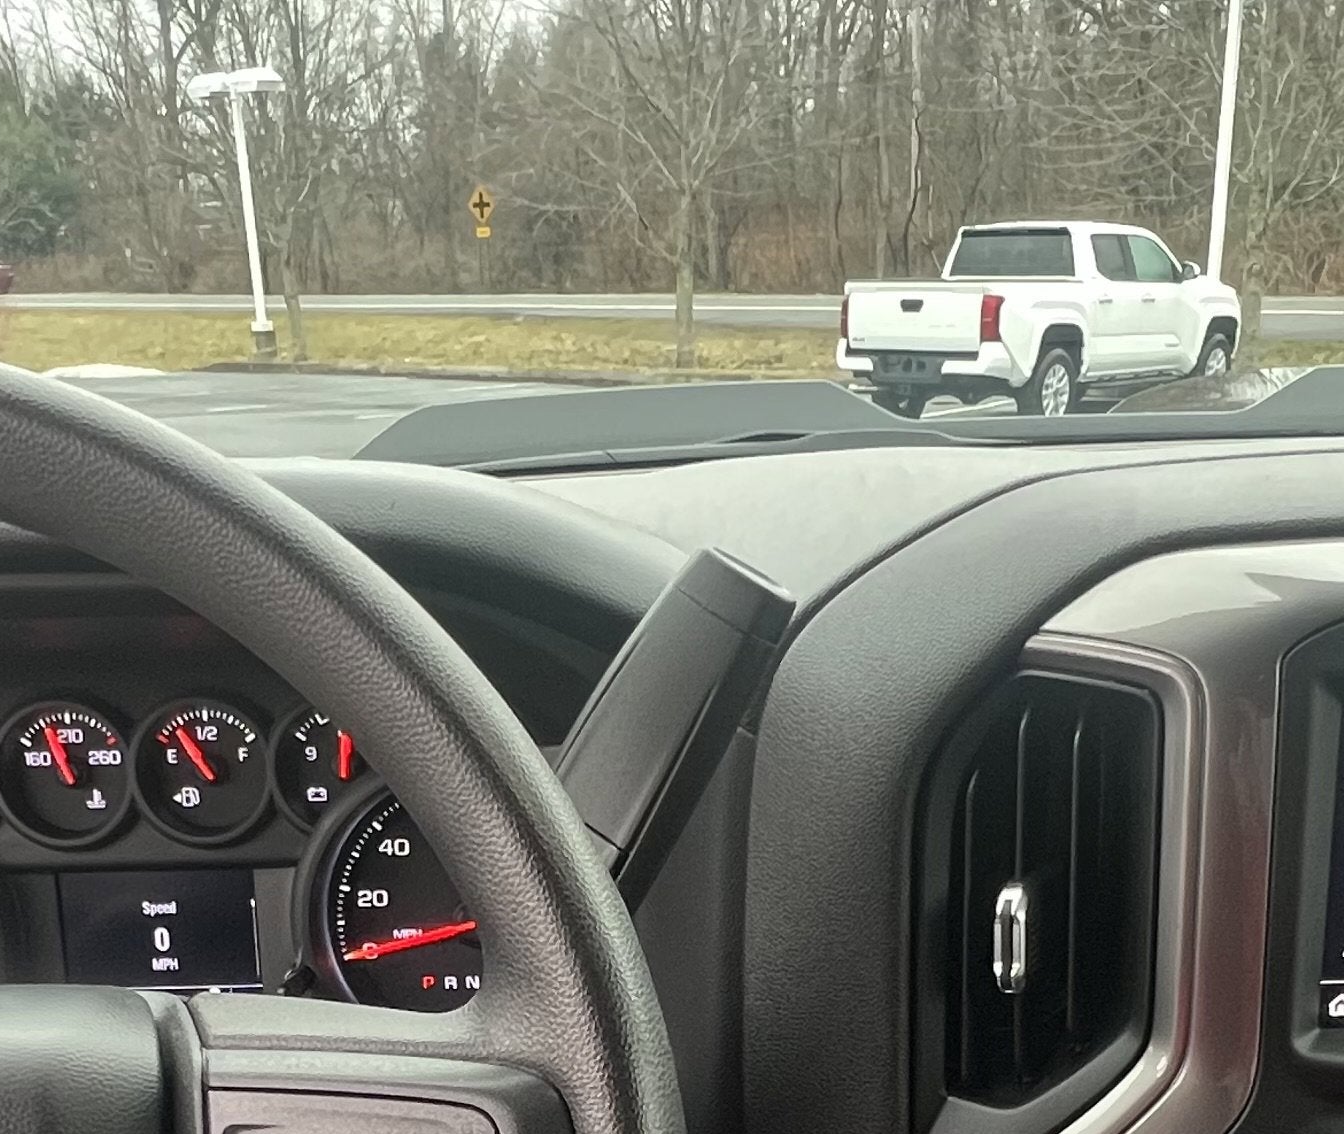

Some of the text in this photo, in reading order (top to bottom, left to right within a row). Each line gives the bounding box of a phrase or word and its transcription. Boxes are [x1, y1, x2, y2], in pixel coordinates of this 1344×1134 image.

[56, 729, 84, 744] 210
[195, 726, 218, 741] 1/2
[24, 751, 51, 767] 160
[88, 750, 122, 765] 260
[166, 749, 179, 764] E
[237, 747, 249, 762] F
[305, 746, 318, 762] 9
[378, 838, 410, 856] 40
[357, 889, 389, 907] 20
[141, 900, 177, 917] Speed
[154, 926, 171, 952] 0
[392, 928, 423, 940] MPH
[151, 957, 179, 971] MPH
[422, 975, 480, 990] P R N
